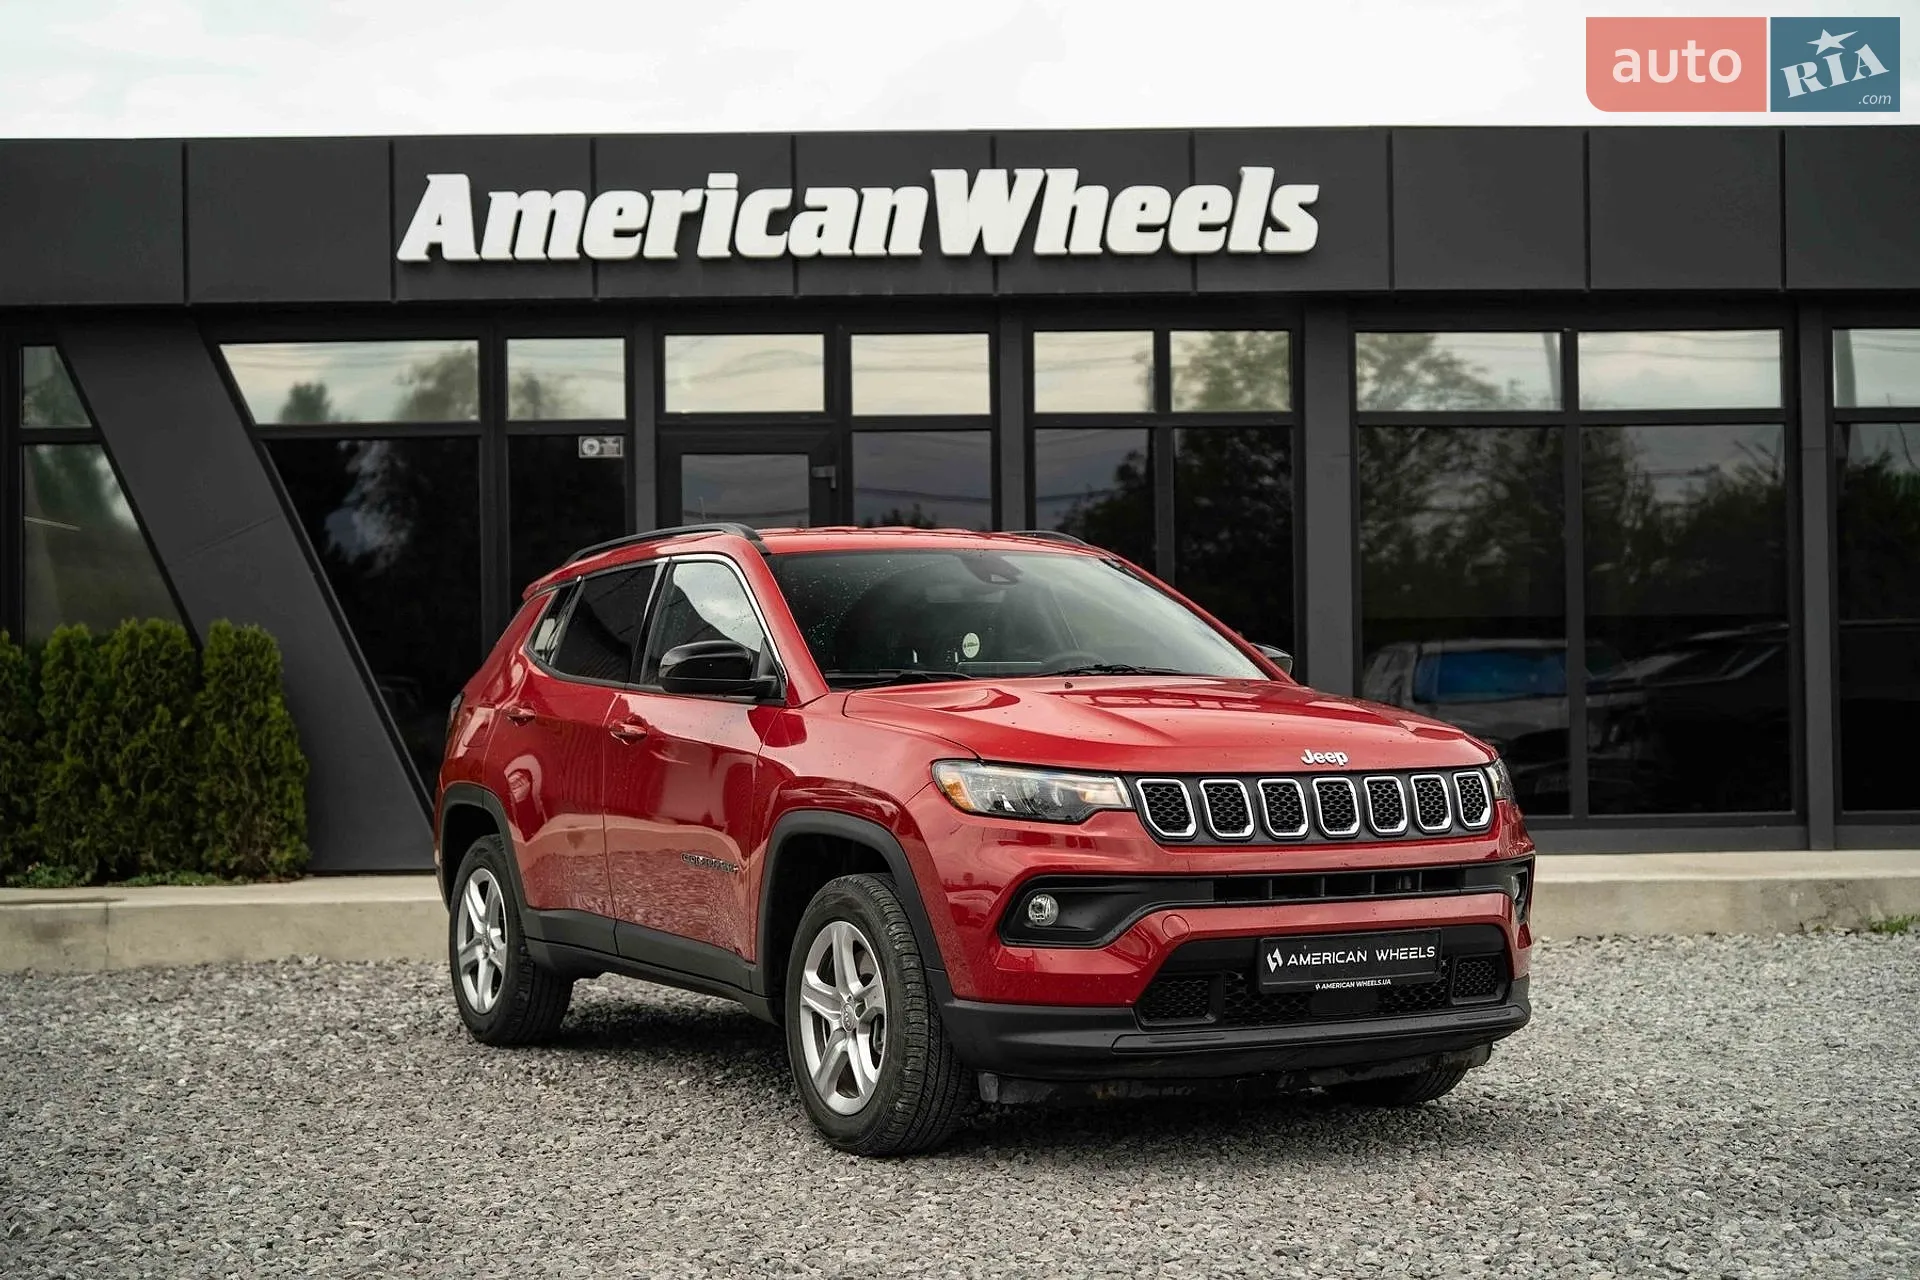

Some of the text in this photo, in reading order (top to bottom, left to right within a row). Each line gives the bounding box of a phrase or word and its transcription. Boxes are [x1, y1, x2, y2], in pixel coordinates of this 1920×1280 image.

[396, 166, 1320, 262] AmericanWheels
[1300, 748, 1349, 767] Jeep
[1287, 946, 1436, 966] AMERICAN WHEELS
[1321, 981, 1355, 990] AMERICAN
